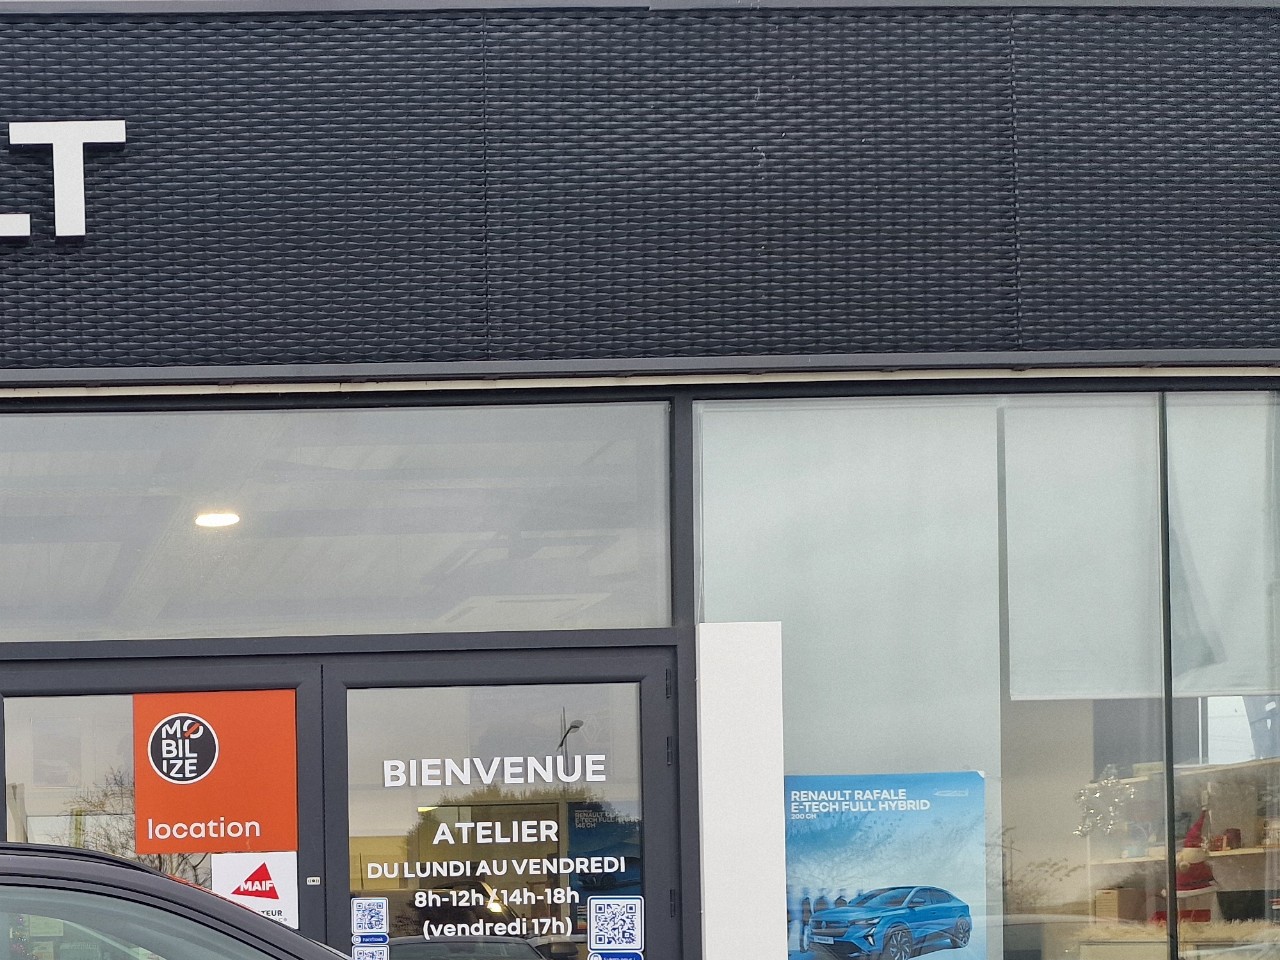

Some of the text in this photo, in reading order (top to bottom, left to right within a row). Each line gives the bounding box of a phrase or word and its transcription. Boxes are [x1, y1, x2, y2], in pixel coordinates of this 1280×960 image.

[383, 754, 607, 788] BIENVENUE
[791, 789, 907, 801] RENAULT RAFALE
[791, 800, 931, 813] E-TECH FULL HYBRID
[147, 817, 262, 840] location
[432, 819, 559, 845] ATELIER
[367, 856, 626, 879] DU LUNDI AU VENDREDI
[239, 880, 275, 892] MAIF
[414, 889, 485, 908] 8h-12h
[500, 887, 580, 906] 14h-18h
[258, 909, 283, 917] TEUR
[422, 916, 574, 941] (vendredi 17h)
